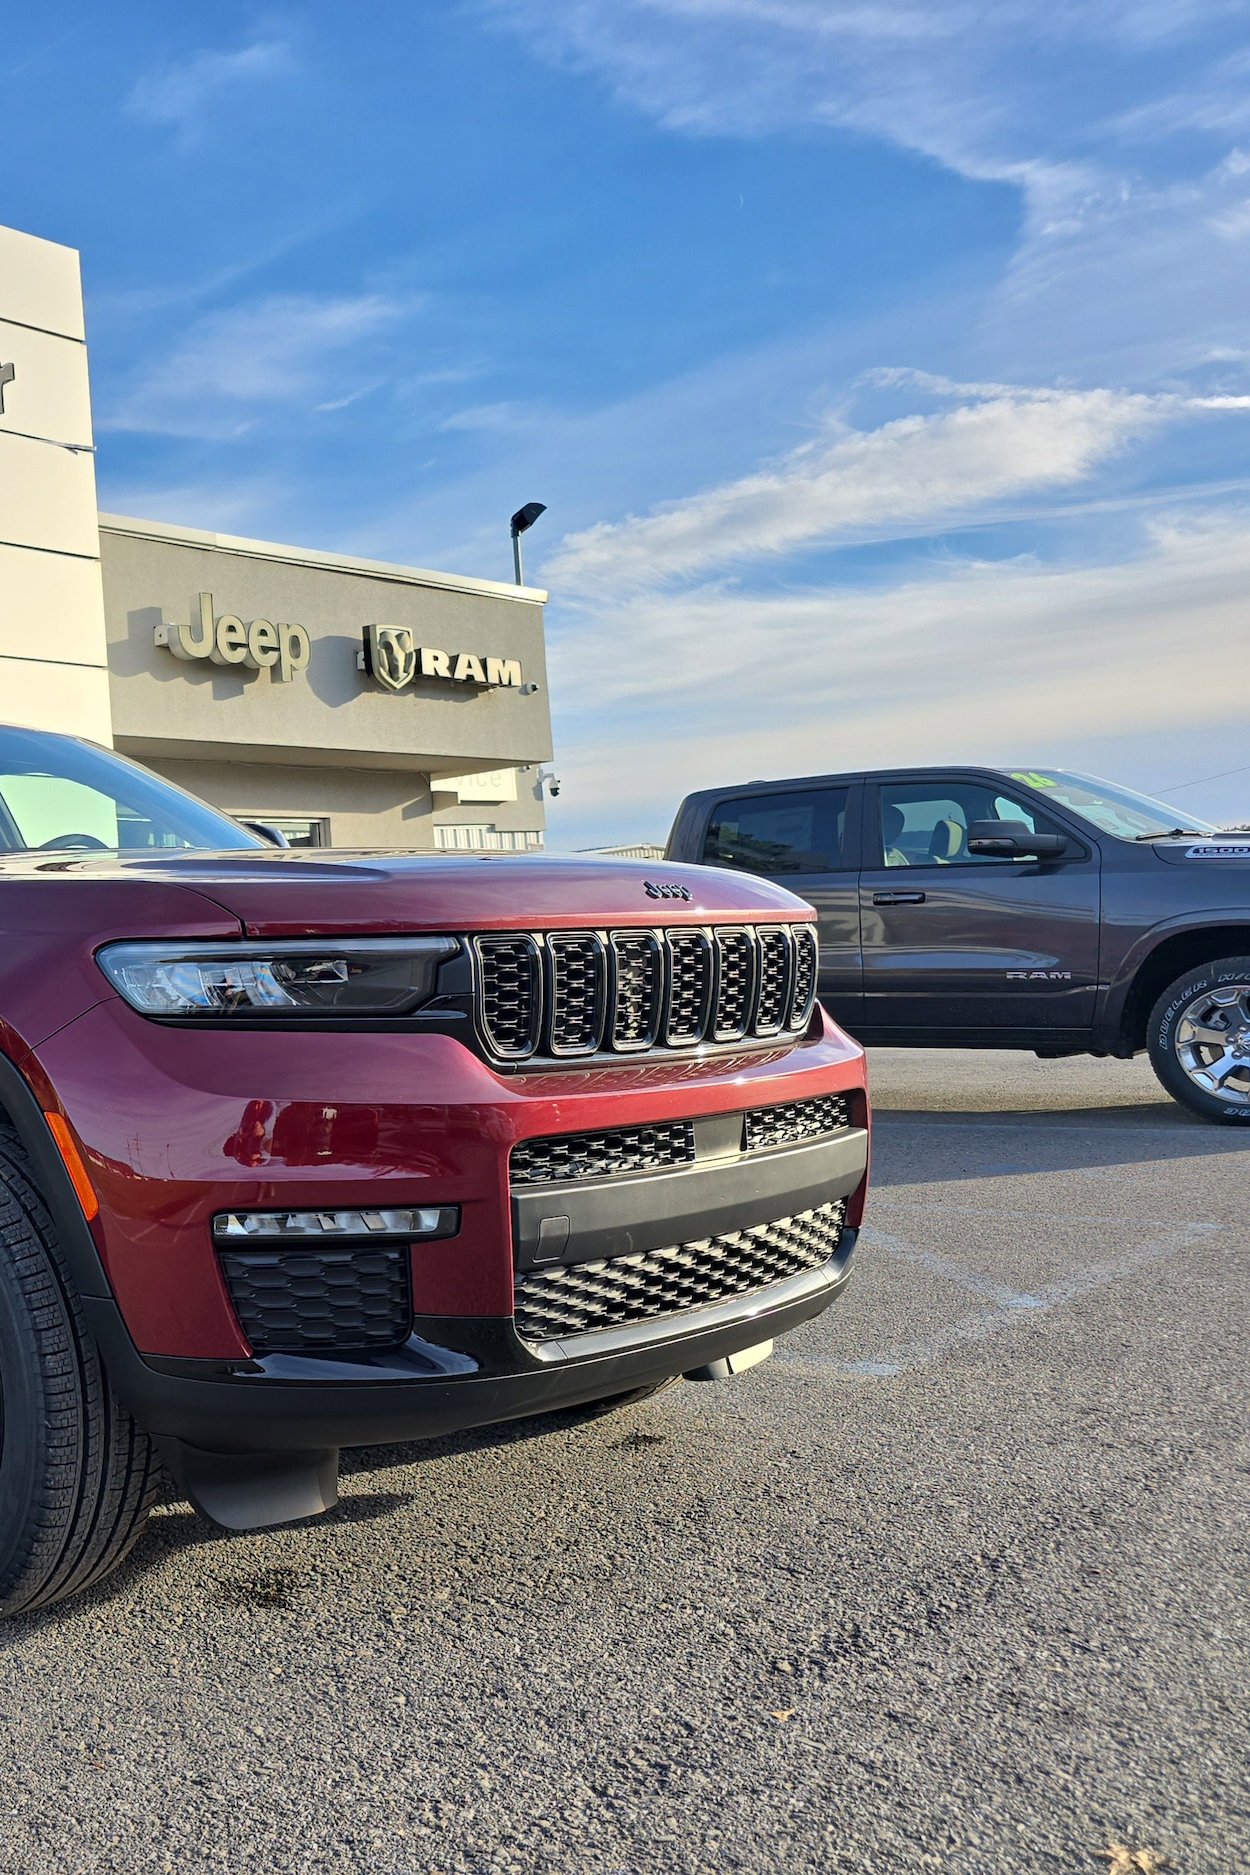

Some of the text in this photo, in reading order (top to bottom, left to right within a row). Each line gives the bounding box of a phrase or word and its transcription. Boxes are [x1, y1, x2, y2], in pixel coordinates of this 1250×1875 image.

[167, 592, 311, 683] Jeep
[419, 647, 523, 688] RAM
[1010, 771, 1057, 789] 26
[642, 880, 693, 903] Jeep
[1005, 971, 1072, 980] RAM
[1158, 979, 1208, 1050] DUELER
